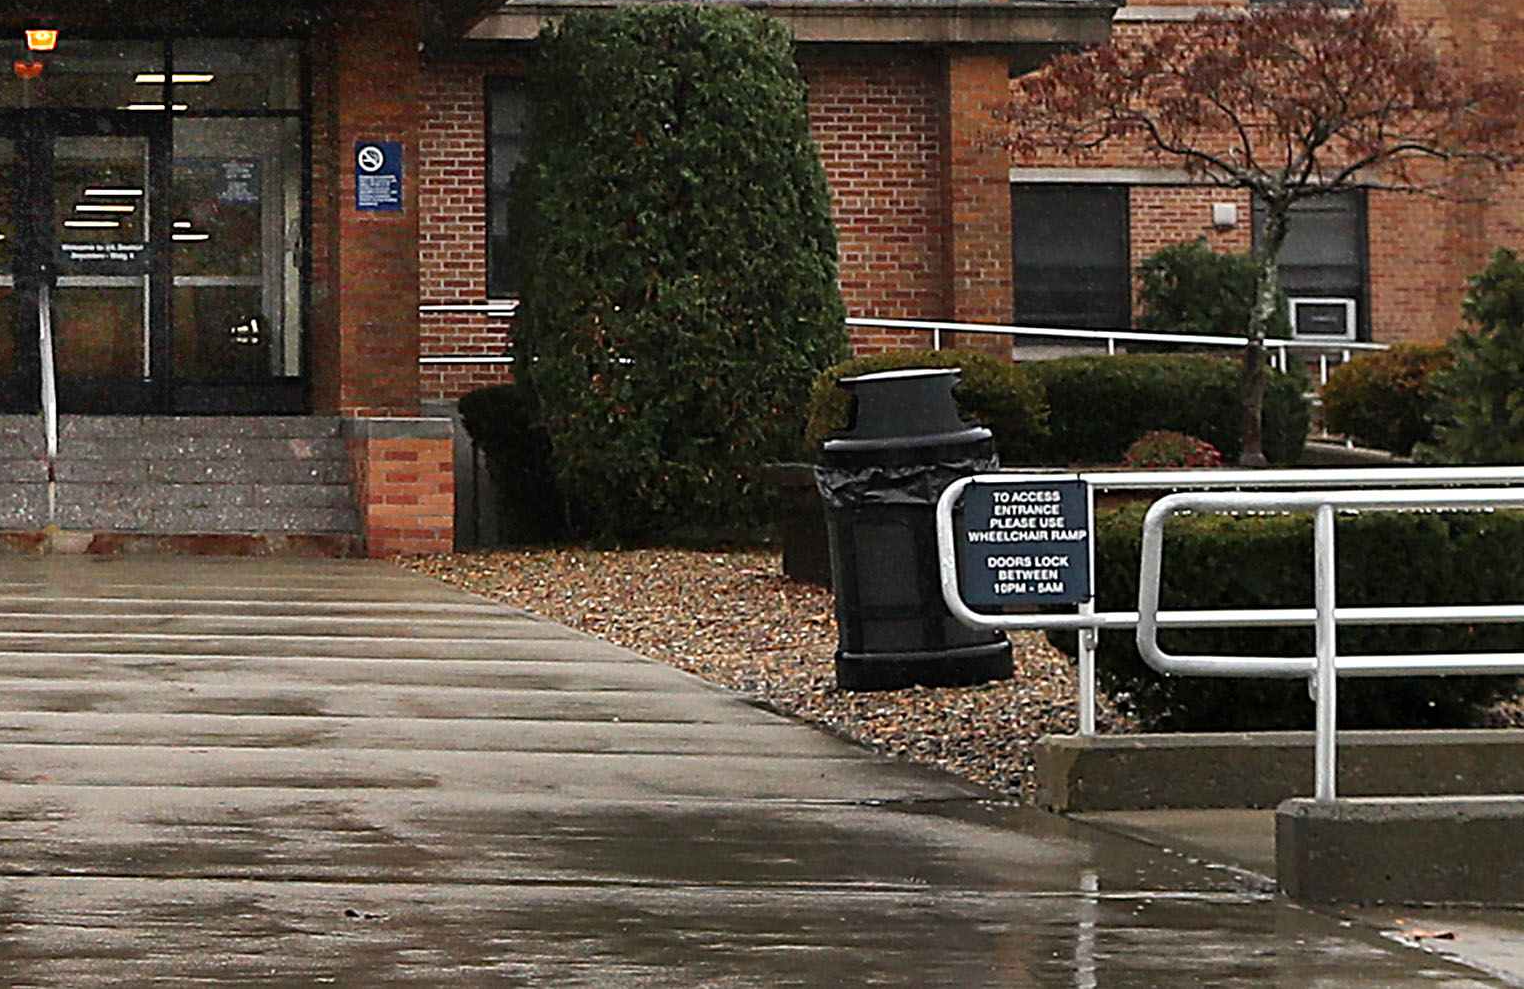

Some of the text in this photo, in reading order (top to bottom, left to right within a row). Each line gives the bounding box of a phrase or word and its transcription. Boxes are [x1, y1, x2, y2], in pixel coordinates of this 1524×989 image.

[993, 491, 1061, 503] TO ACCESS
[994, 504, 1060, 516] ENTRANCE
[989, 517, 1064, 529] PLEASE USE
[967, 530, 1087, 542] WHEELCHAIR RAMP
[987, 556, 1069, 568] DOORS LOCK
[998, 570, 1058, 581] BETWEEN
[994, 583, 1026, 594] 10PM
